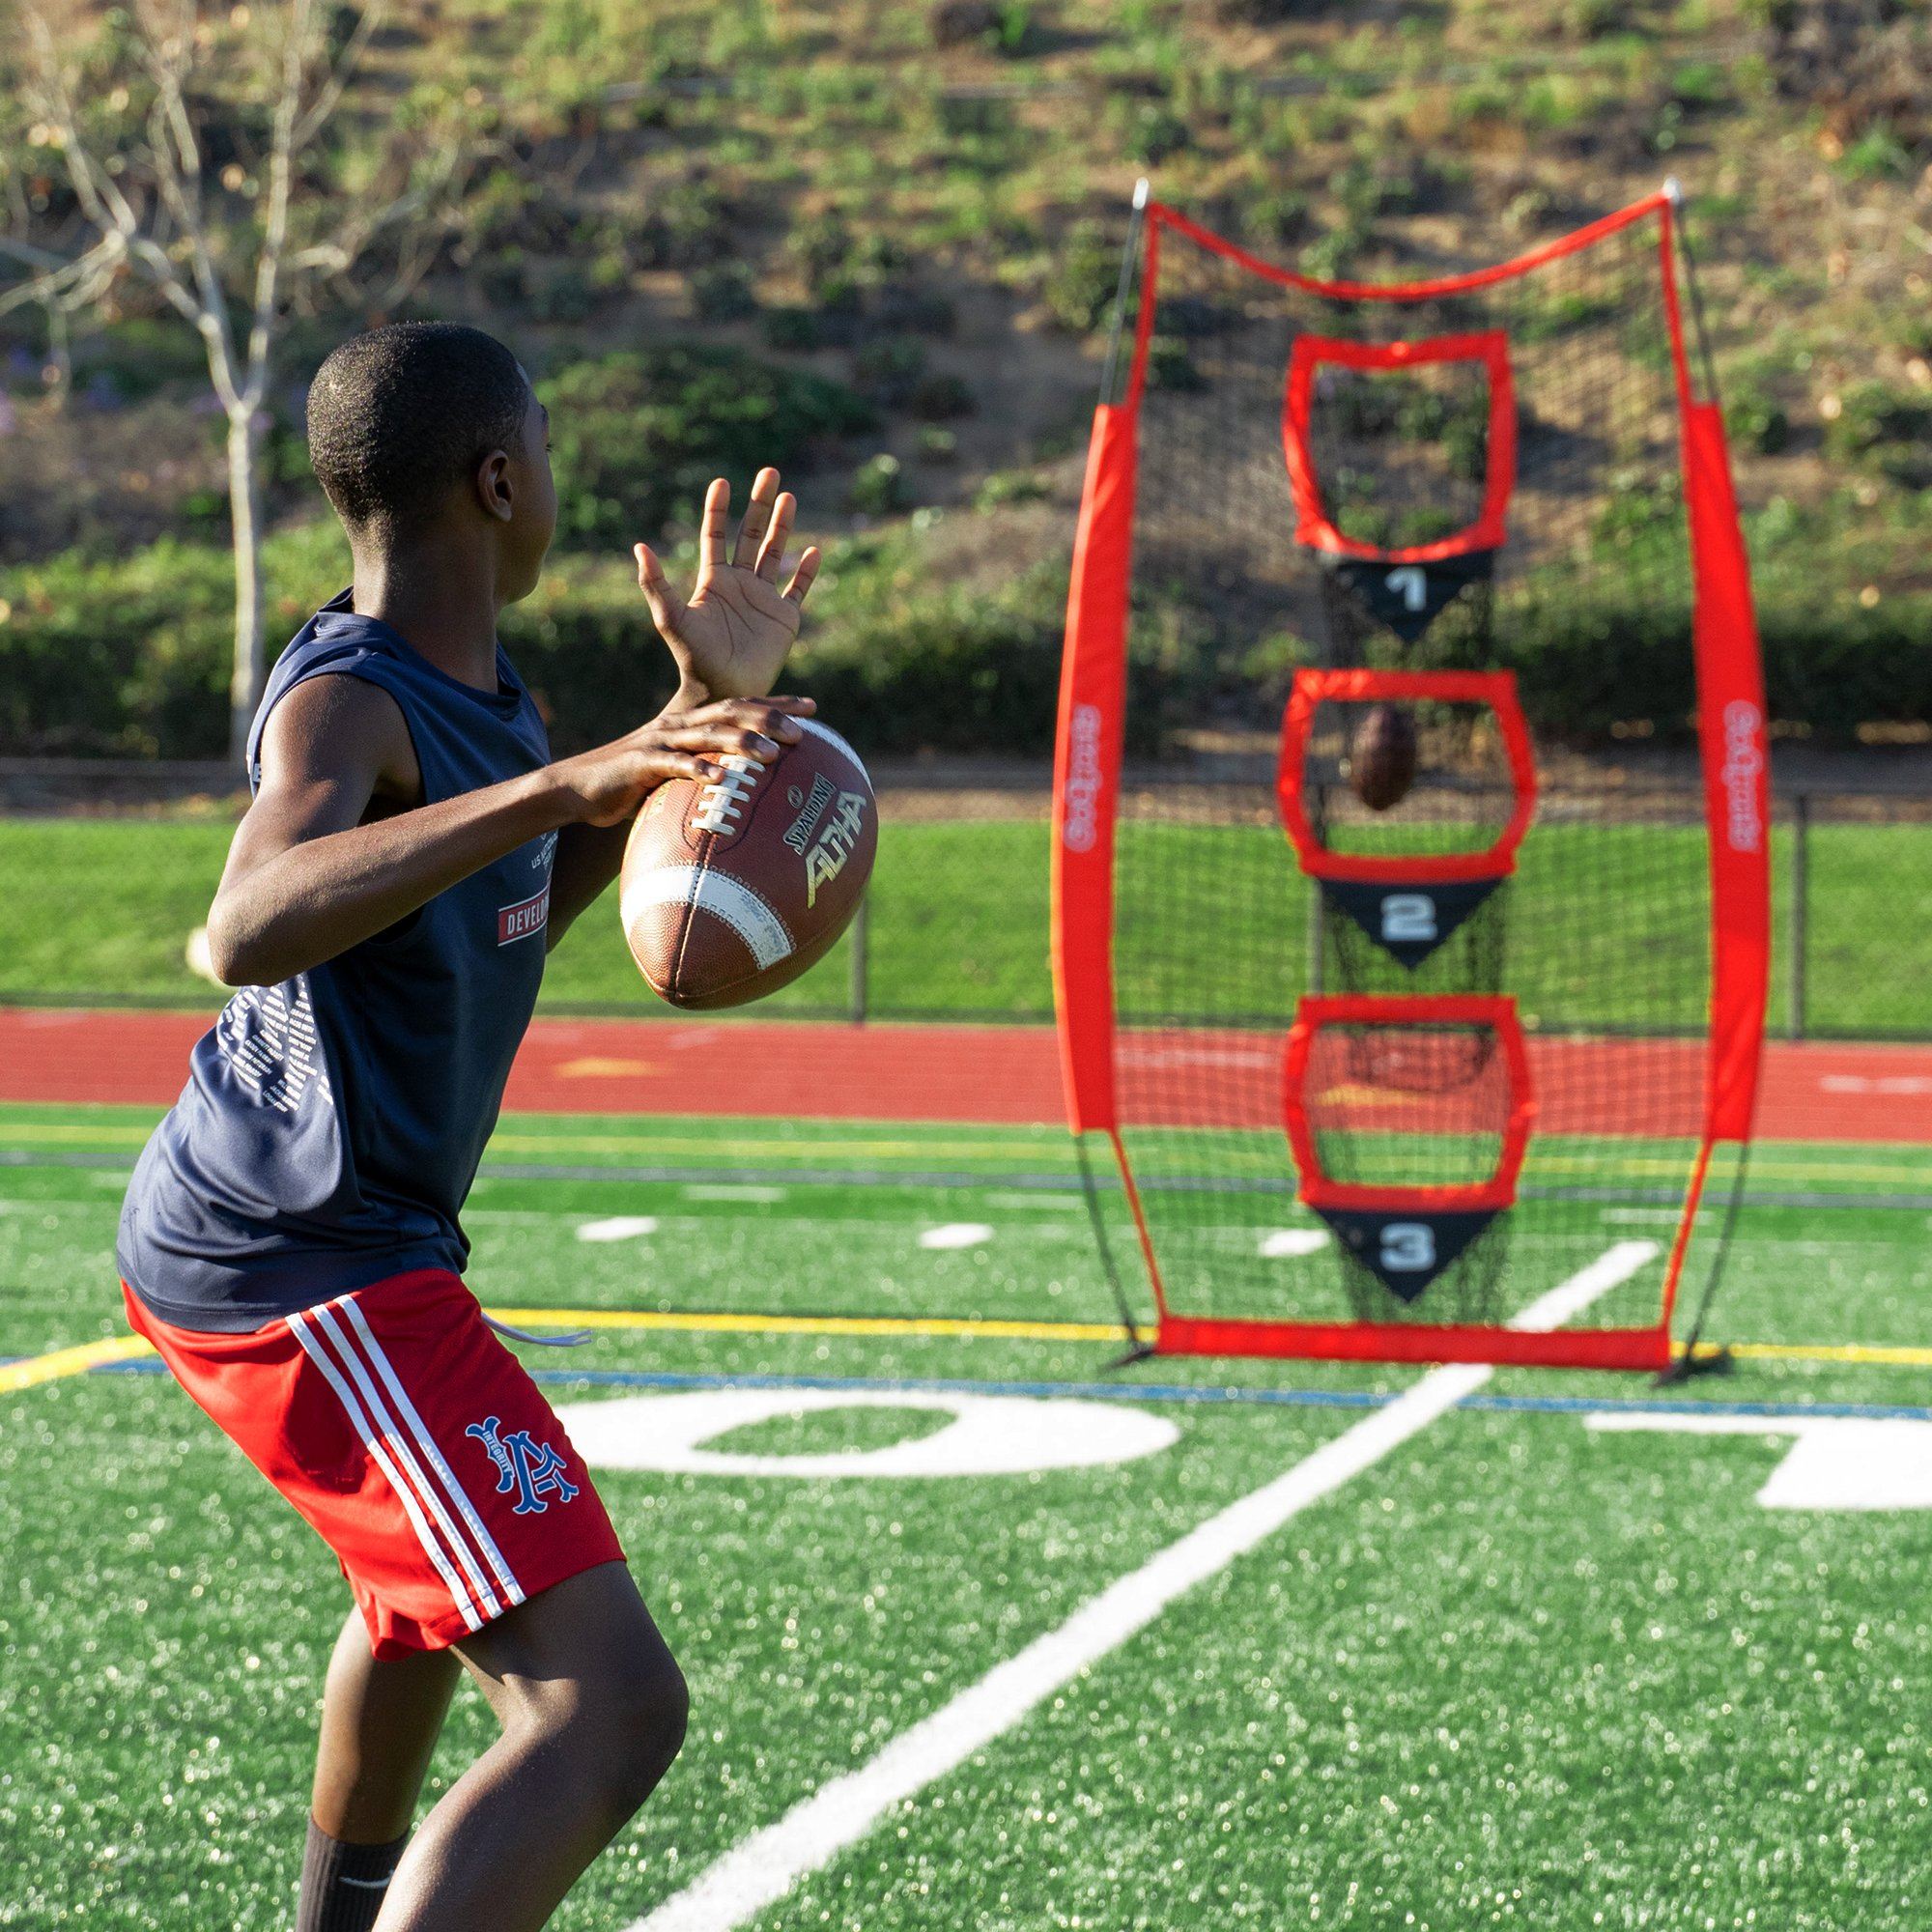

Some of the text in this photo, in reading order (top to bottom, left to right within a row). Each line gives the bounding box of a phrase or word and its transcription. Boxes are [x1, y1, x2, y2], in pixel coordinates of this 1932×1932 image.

[1384, 566, 1427, 611] 1
[782, 772, 837, 856] SPALDING
[806, 791, 867, 909] ALPHA
[1379, 894, 1437, 942] 2
[1379, 1222, 1436, 1271] 3
[482, 1430, 514, 1473] INTEGRITY
